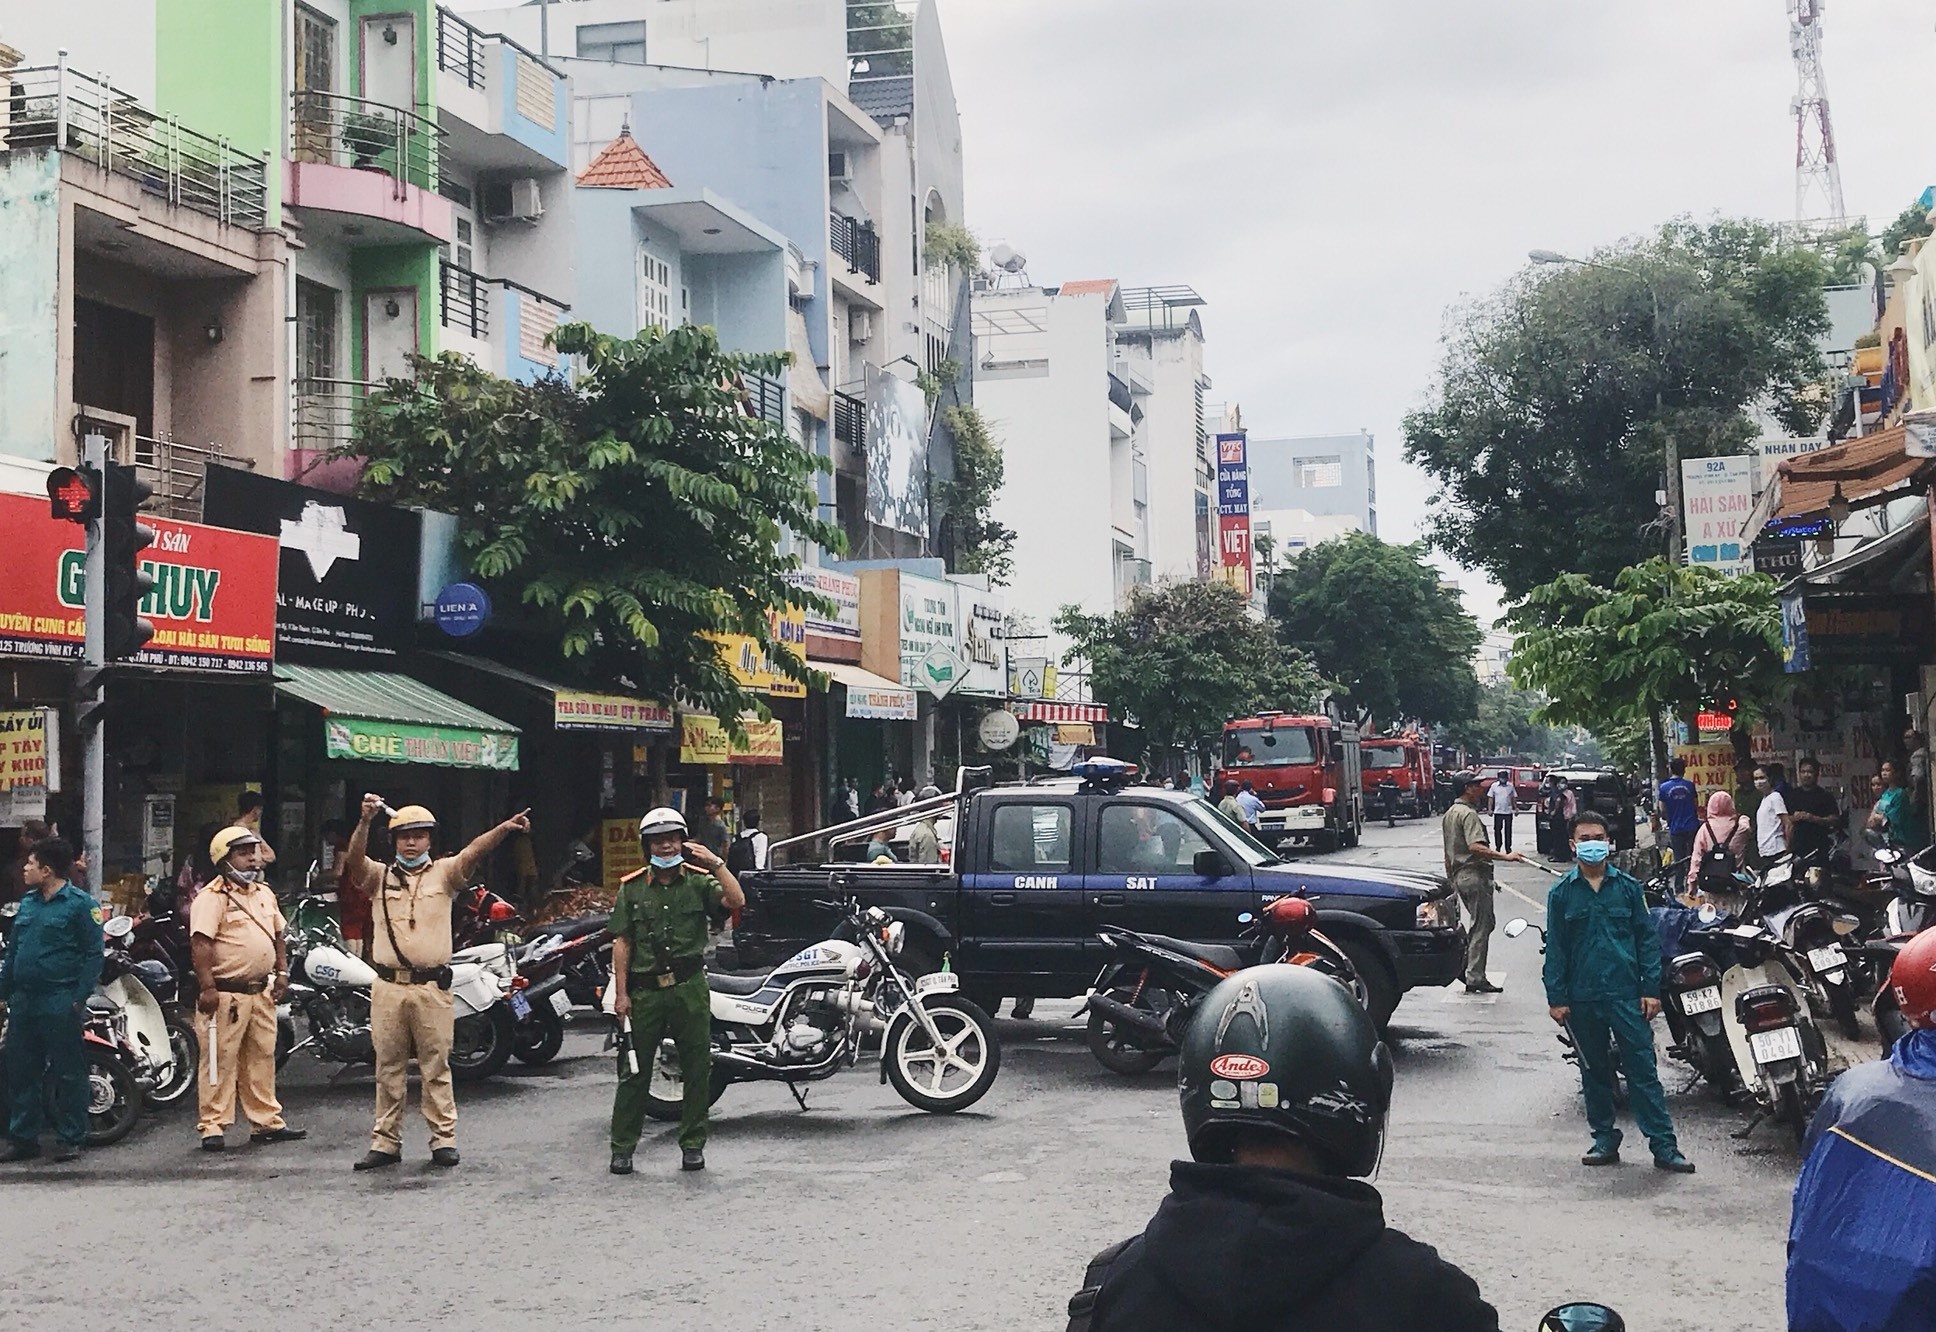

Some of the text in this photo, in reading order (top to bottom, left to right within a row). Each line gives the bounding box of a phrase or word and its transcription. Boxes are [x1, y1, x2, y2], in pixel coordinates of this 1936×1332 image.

[1706, 461, 1726, 472] 92A
[161, 527, 192, 553] SẢN
[137, 560, 221, 622] HUY
[325, 599, 338, 613] UP
[34, 616, 66, 635] CUNG
[352, 731, 402, 756] CHÈ
[1014, 876, 1158, 890] CANH SAT
[315, 964, 342, 979] CSGT
[735, 1003, 768, 1014] POLICE
[1686, 997, 1720, 1015] 31886
[1761, 1043, 1794, 1061] 0494
